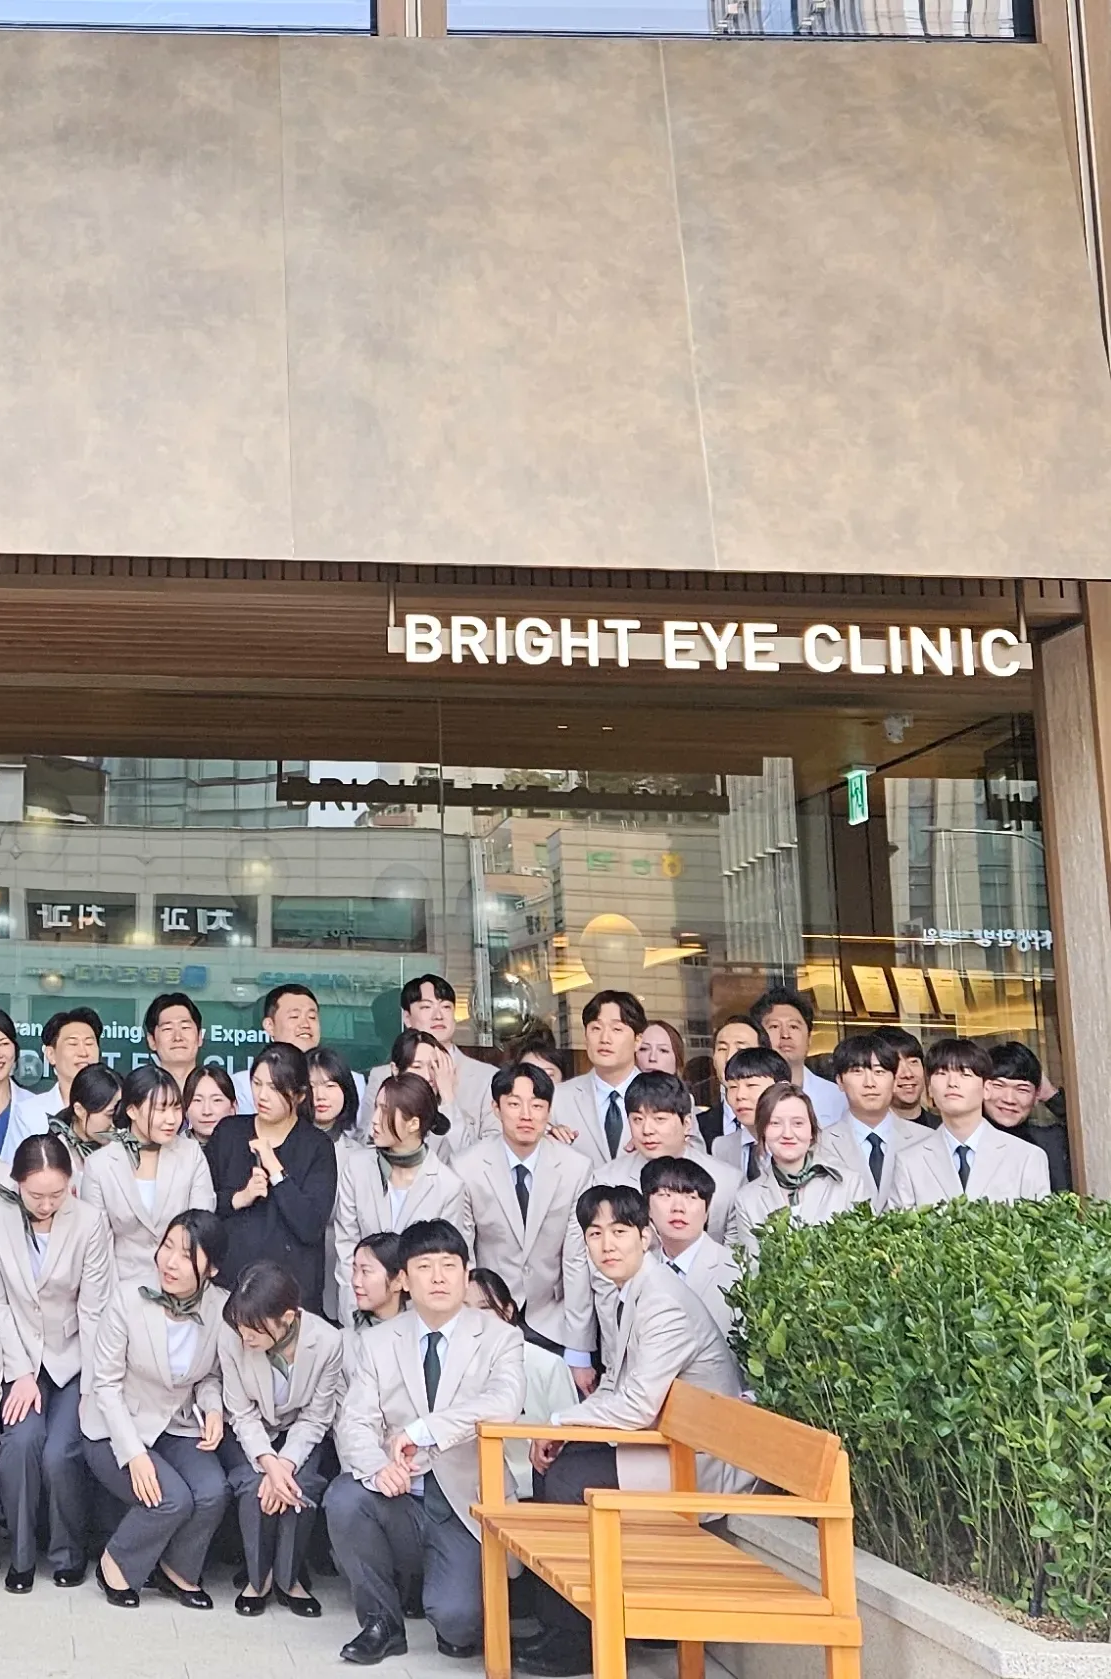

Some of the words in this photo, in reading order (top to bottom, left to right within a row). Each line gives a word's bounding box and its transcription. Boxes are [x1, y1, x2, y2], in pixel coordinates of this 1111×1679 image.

[404, 613, 640, 667] BRIGHT
[663, 620, 781, 672] EYE
[803, 623, 1021, 677] CLINIC
